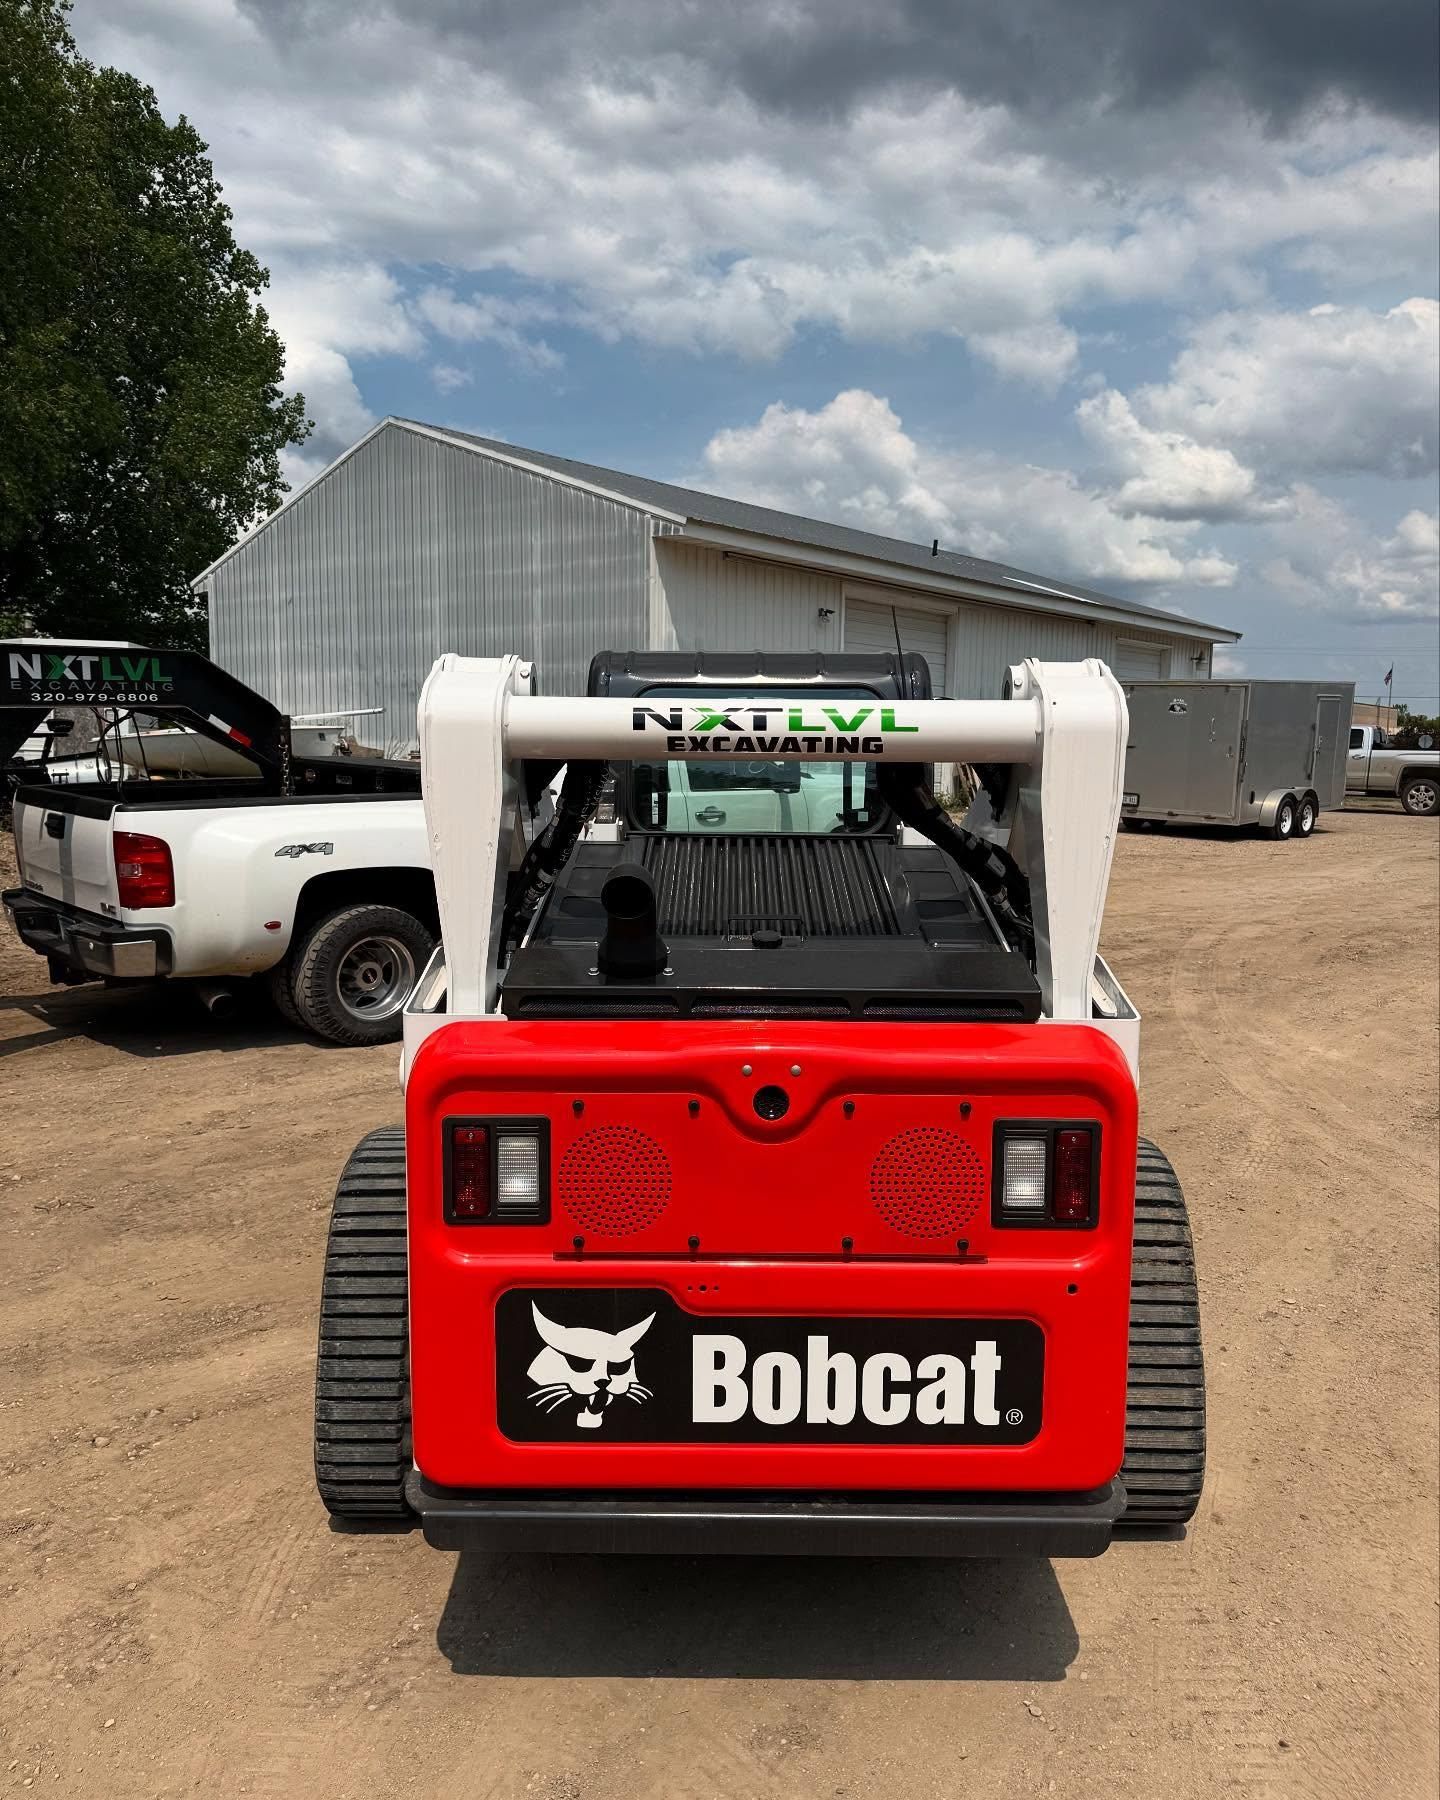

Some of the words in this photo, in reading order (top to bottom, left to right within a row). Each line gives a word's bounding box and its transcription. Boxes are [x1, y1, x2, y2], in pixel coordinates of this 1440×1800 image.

[10, 680, 175, 691] EXCAVATING
[31, 692, 159, 702] 320-979-6806
[666, 735, 884, 754] EXCAVATING
[692, 1334, 1002, 1426] Bobcat
